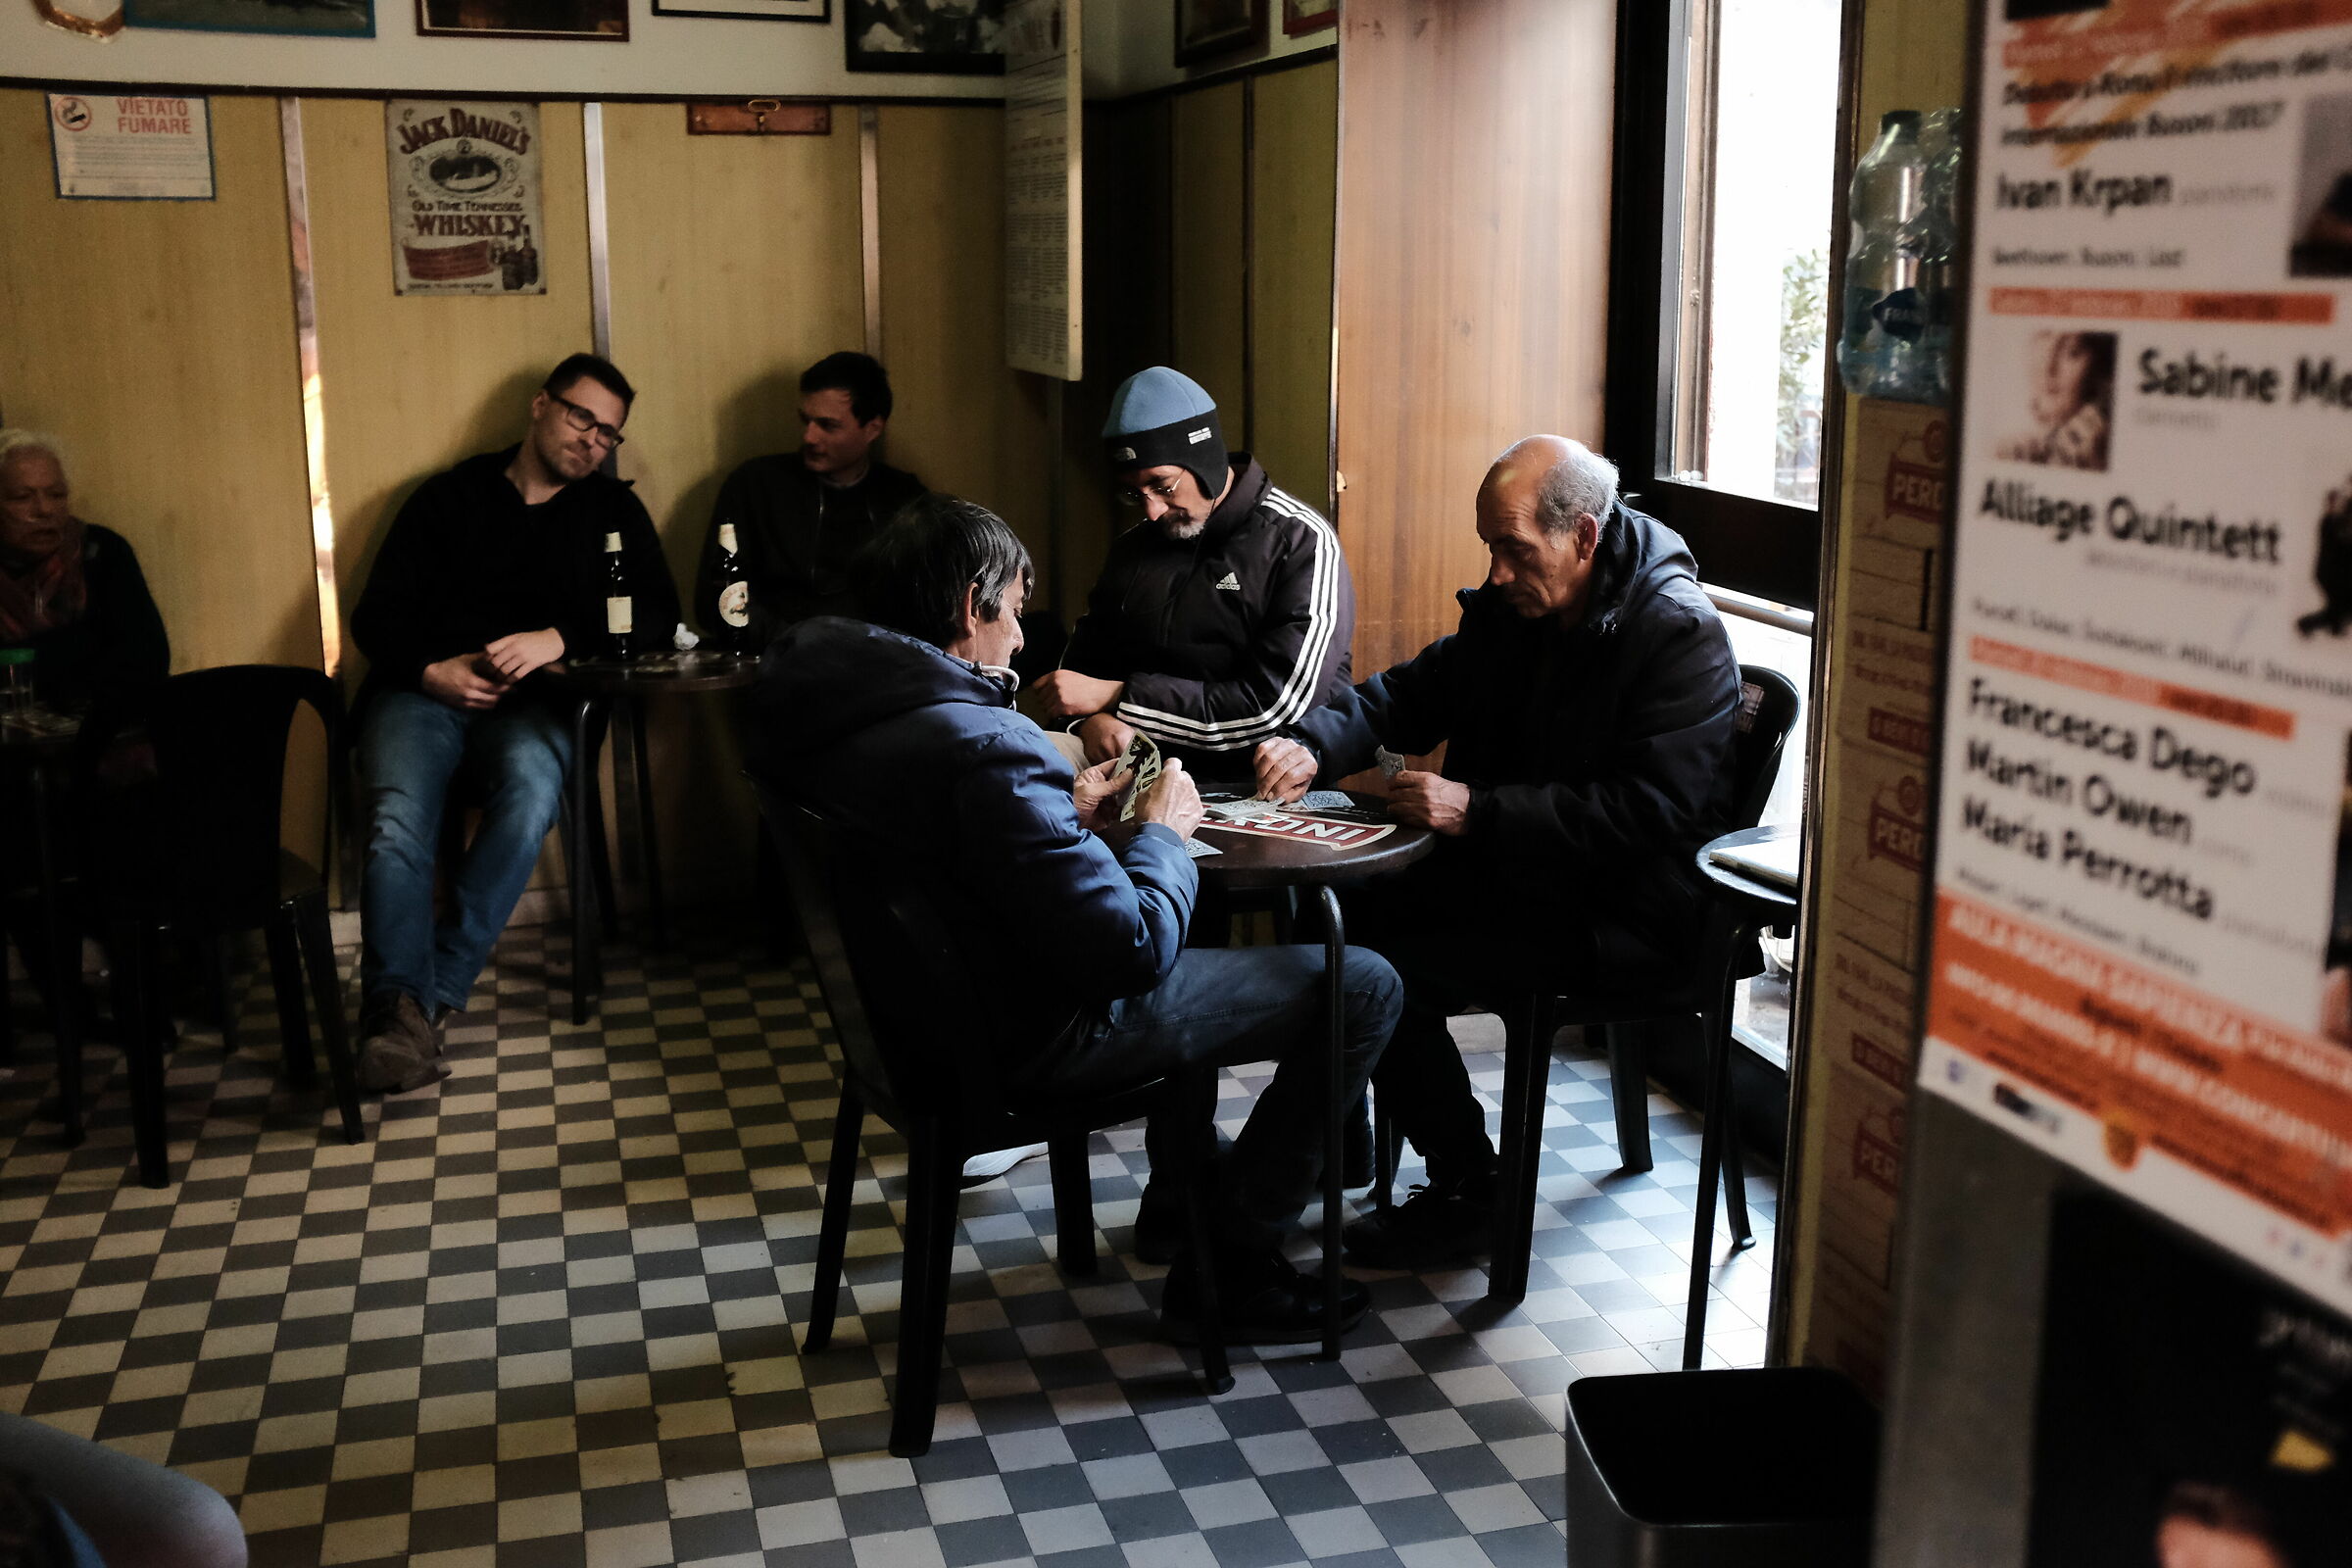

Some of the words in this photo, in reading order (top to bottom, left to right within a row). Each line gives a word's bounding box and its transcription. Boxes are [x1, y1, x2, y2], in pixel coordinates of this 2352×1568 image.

[116, 97, 188, 117] VIETATO
[118, 117, 191, 134] FUMARE
[397, 115, 450, 154] JACK
[450, 108, 531, 155] DANIEL'S
[1995, 172, 2061, 210] Ivan
[2068, 169, 2173, 218] Krpan
[413, 214, 527, 237] WHISKEY
[2139, 348, 2279, 403] Sabine
[1980, 477, 2095, 542] Alliage
[2106, 495, 2280, 564] Quintett
[1968, 676, 2138, 760] Francesca
[2150, 725, 2257, 799] Dego
[1966, 738, 2073, 808] Martin
[2082, 774, 2193, 845] Owen
[1962, 796, 2051, 860] Maria
[2062, 829, 2214, 921] Perrotta
